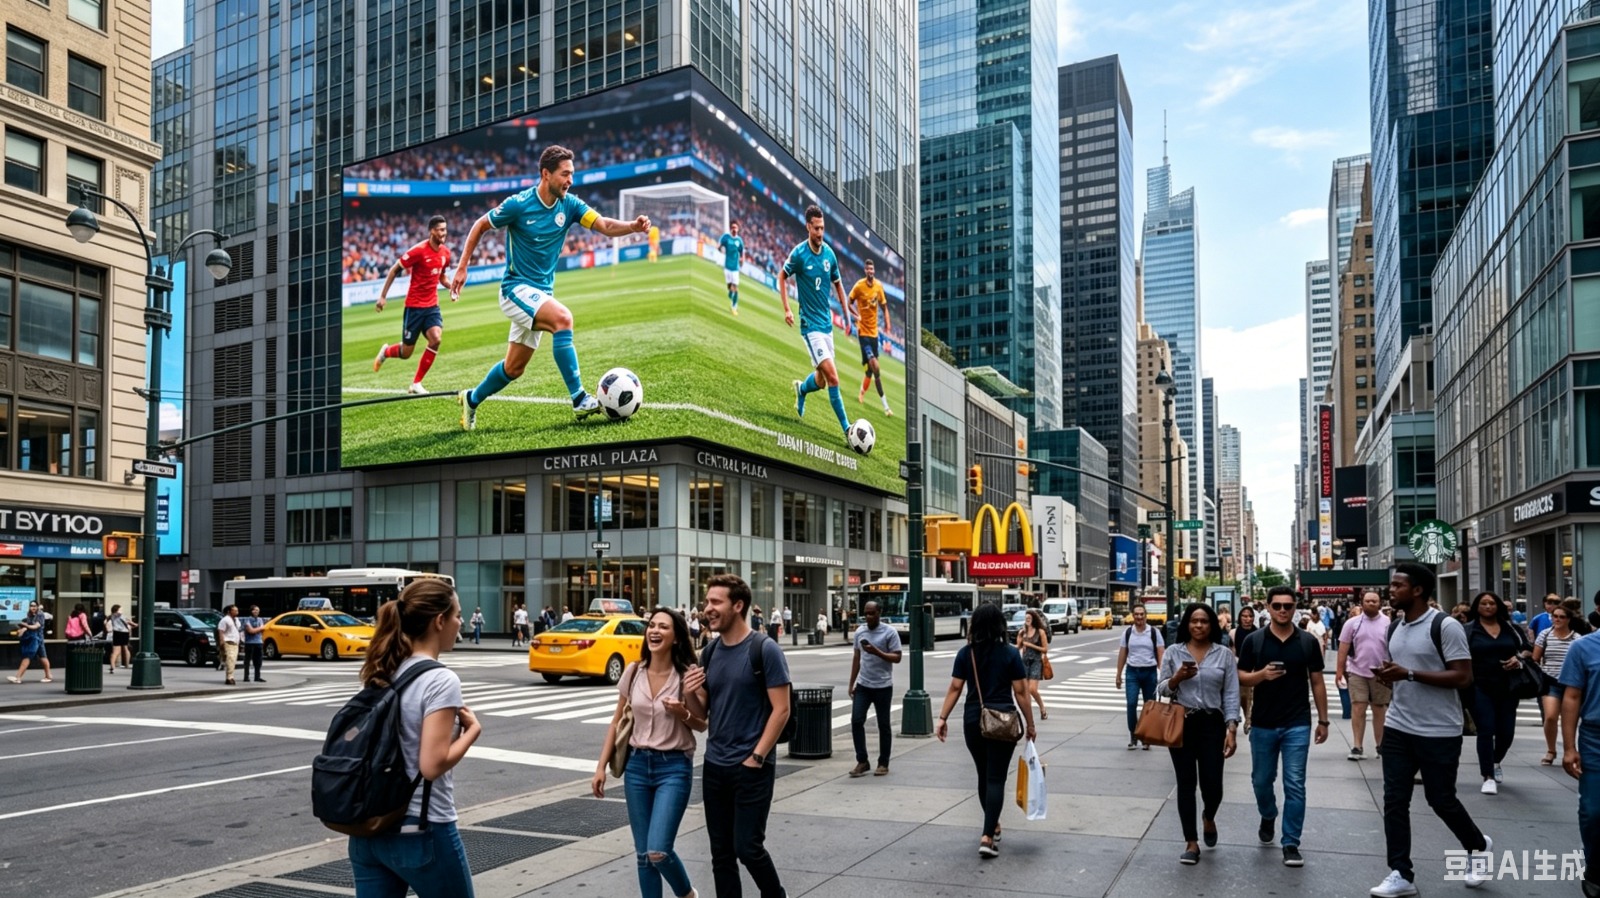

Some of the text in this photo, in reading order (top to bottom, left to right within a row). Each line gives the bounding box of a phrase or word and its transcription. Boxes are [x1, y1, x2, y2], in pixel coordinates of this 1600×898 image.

[544, 449, 658, 470] CENTRAL PLAZA
[697, 451, 739, 473] CENTRAL
[15, 511, 50, 531] BY
